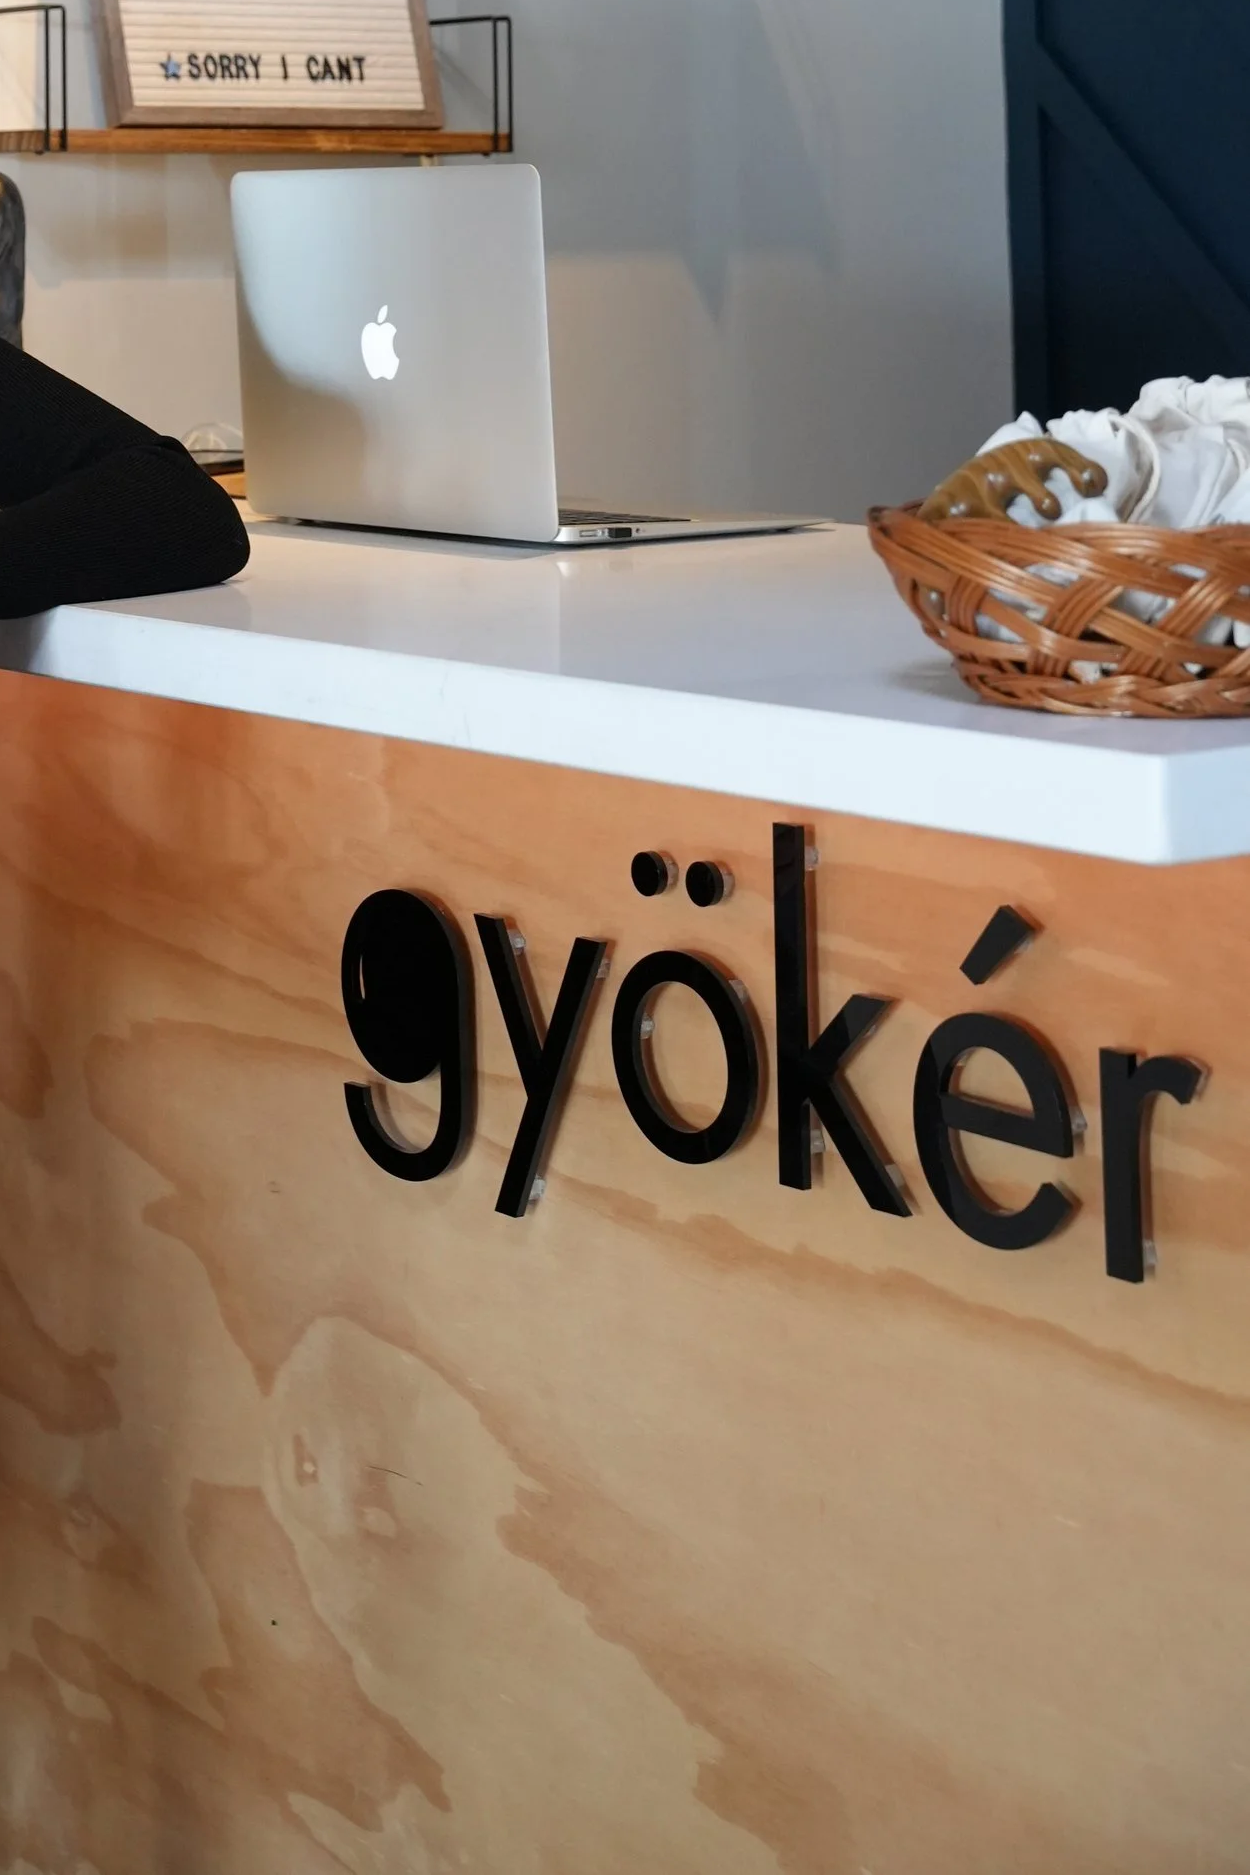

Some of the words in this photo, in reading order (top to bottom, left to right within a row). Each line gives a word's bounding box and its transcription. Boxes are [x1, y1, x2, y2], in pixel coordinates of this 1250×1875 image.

[187, 53, 261, 80] SORRY
[280, 54, 289, 81] I
[305, 54, 366, 82] CANT
[340, 822, 1206, 1284] gyökér
